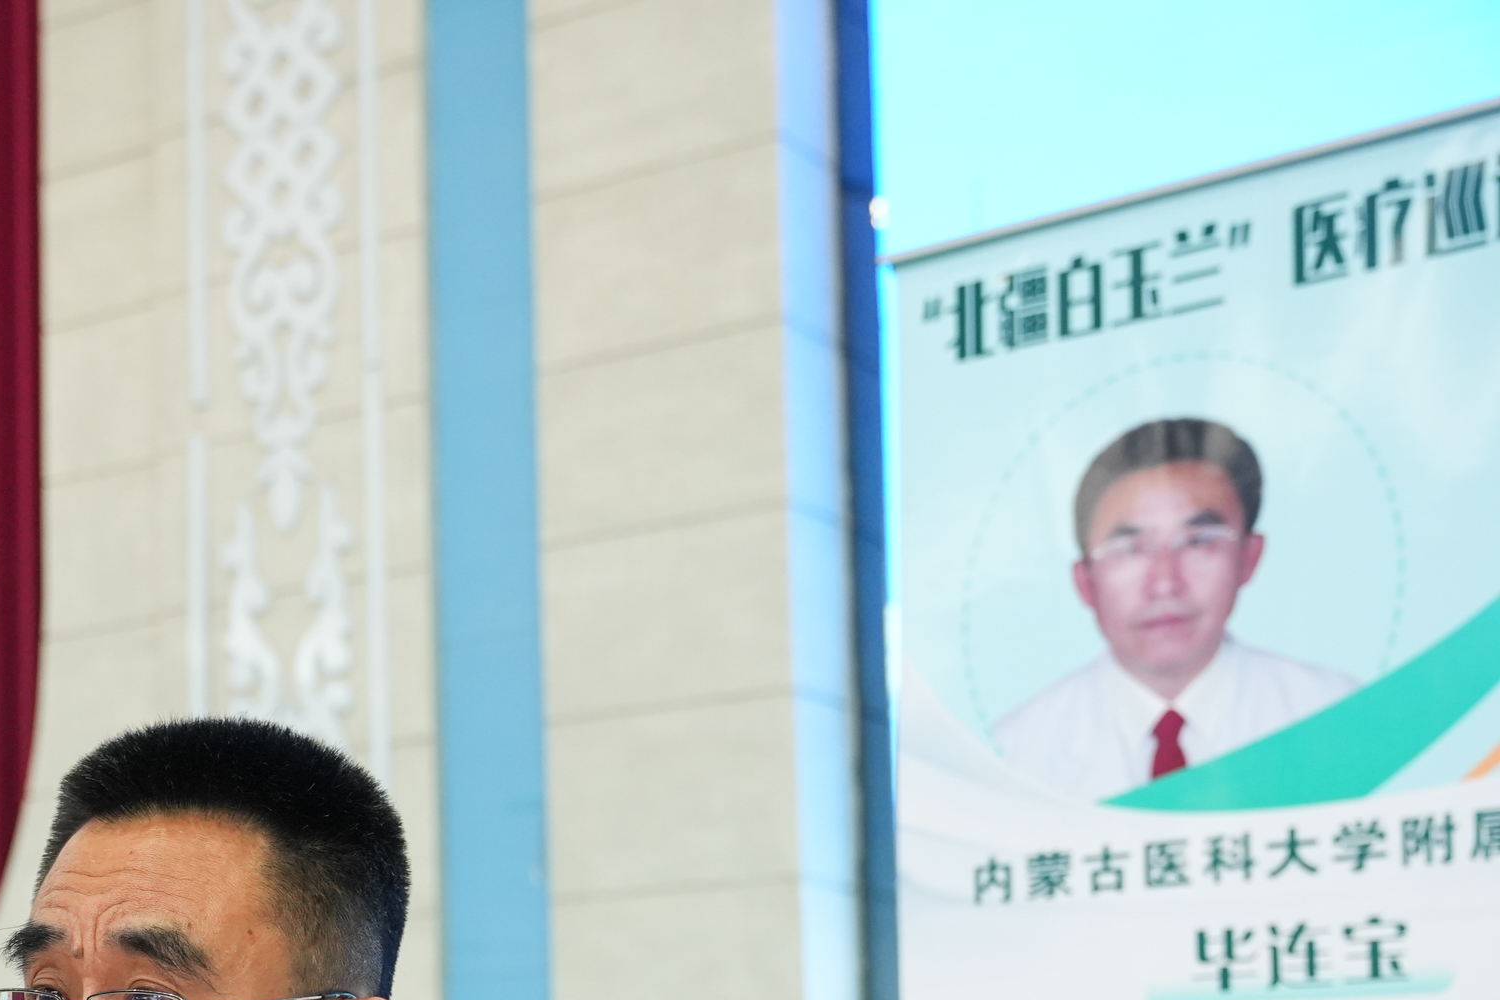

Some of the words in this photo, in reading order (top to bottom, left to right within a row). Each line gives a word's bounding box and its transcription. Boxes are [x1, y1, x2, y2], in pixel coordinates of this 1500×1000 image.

[1293, 152, 1500, 287] 医疗巡
[1191, 915, 1409, 991] 毕连宝
